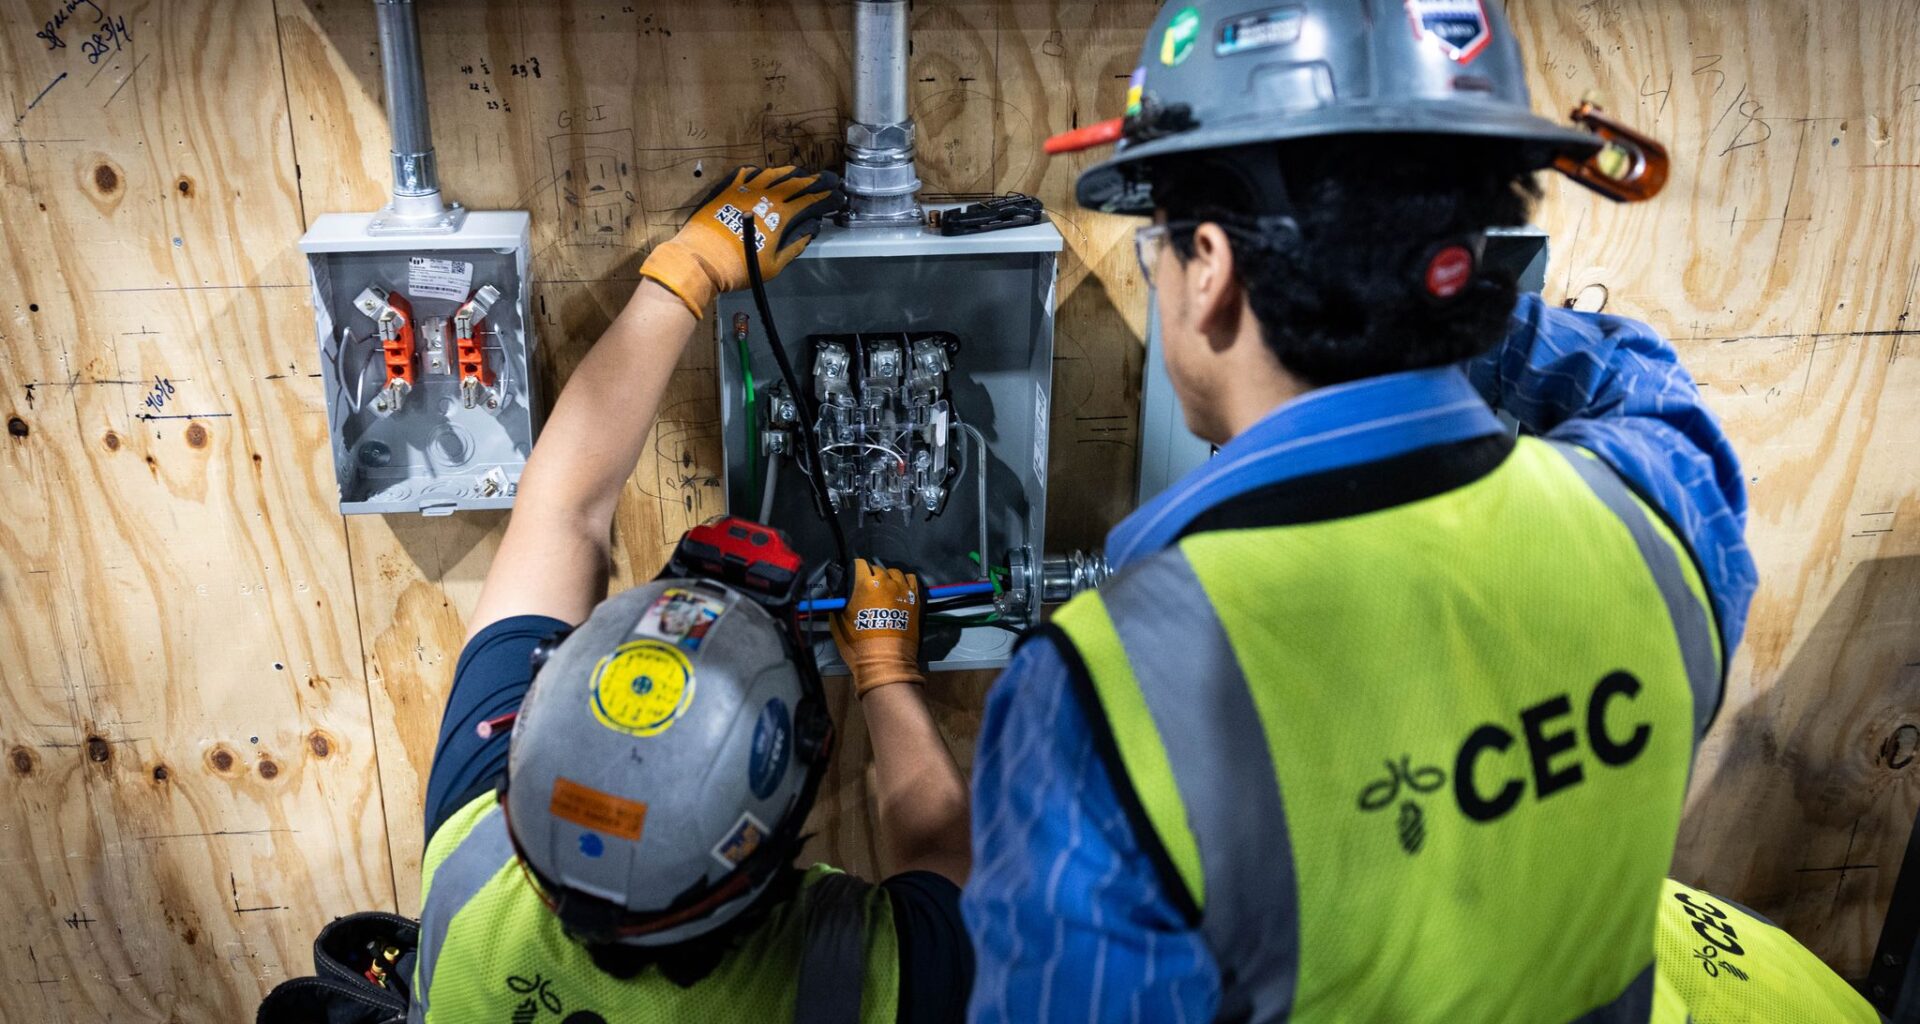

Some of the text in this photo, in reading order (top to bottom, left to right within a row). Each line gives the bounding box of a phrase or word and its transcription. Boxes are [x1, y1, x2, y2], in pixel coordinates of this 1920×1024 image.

[856, 619, 908, 630] KLEIN
[858, 608, 909, 621] TOOLS
[1454, 670, 1653, 823] CEC
[1674, 893, 1745, 956] CEC
